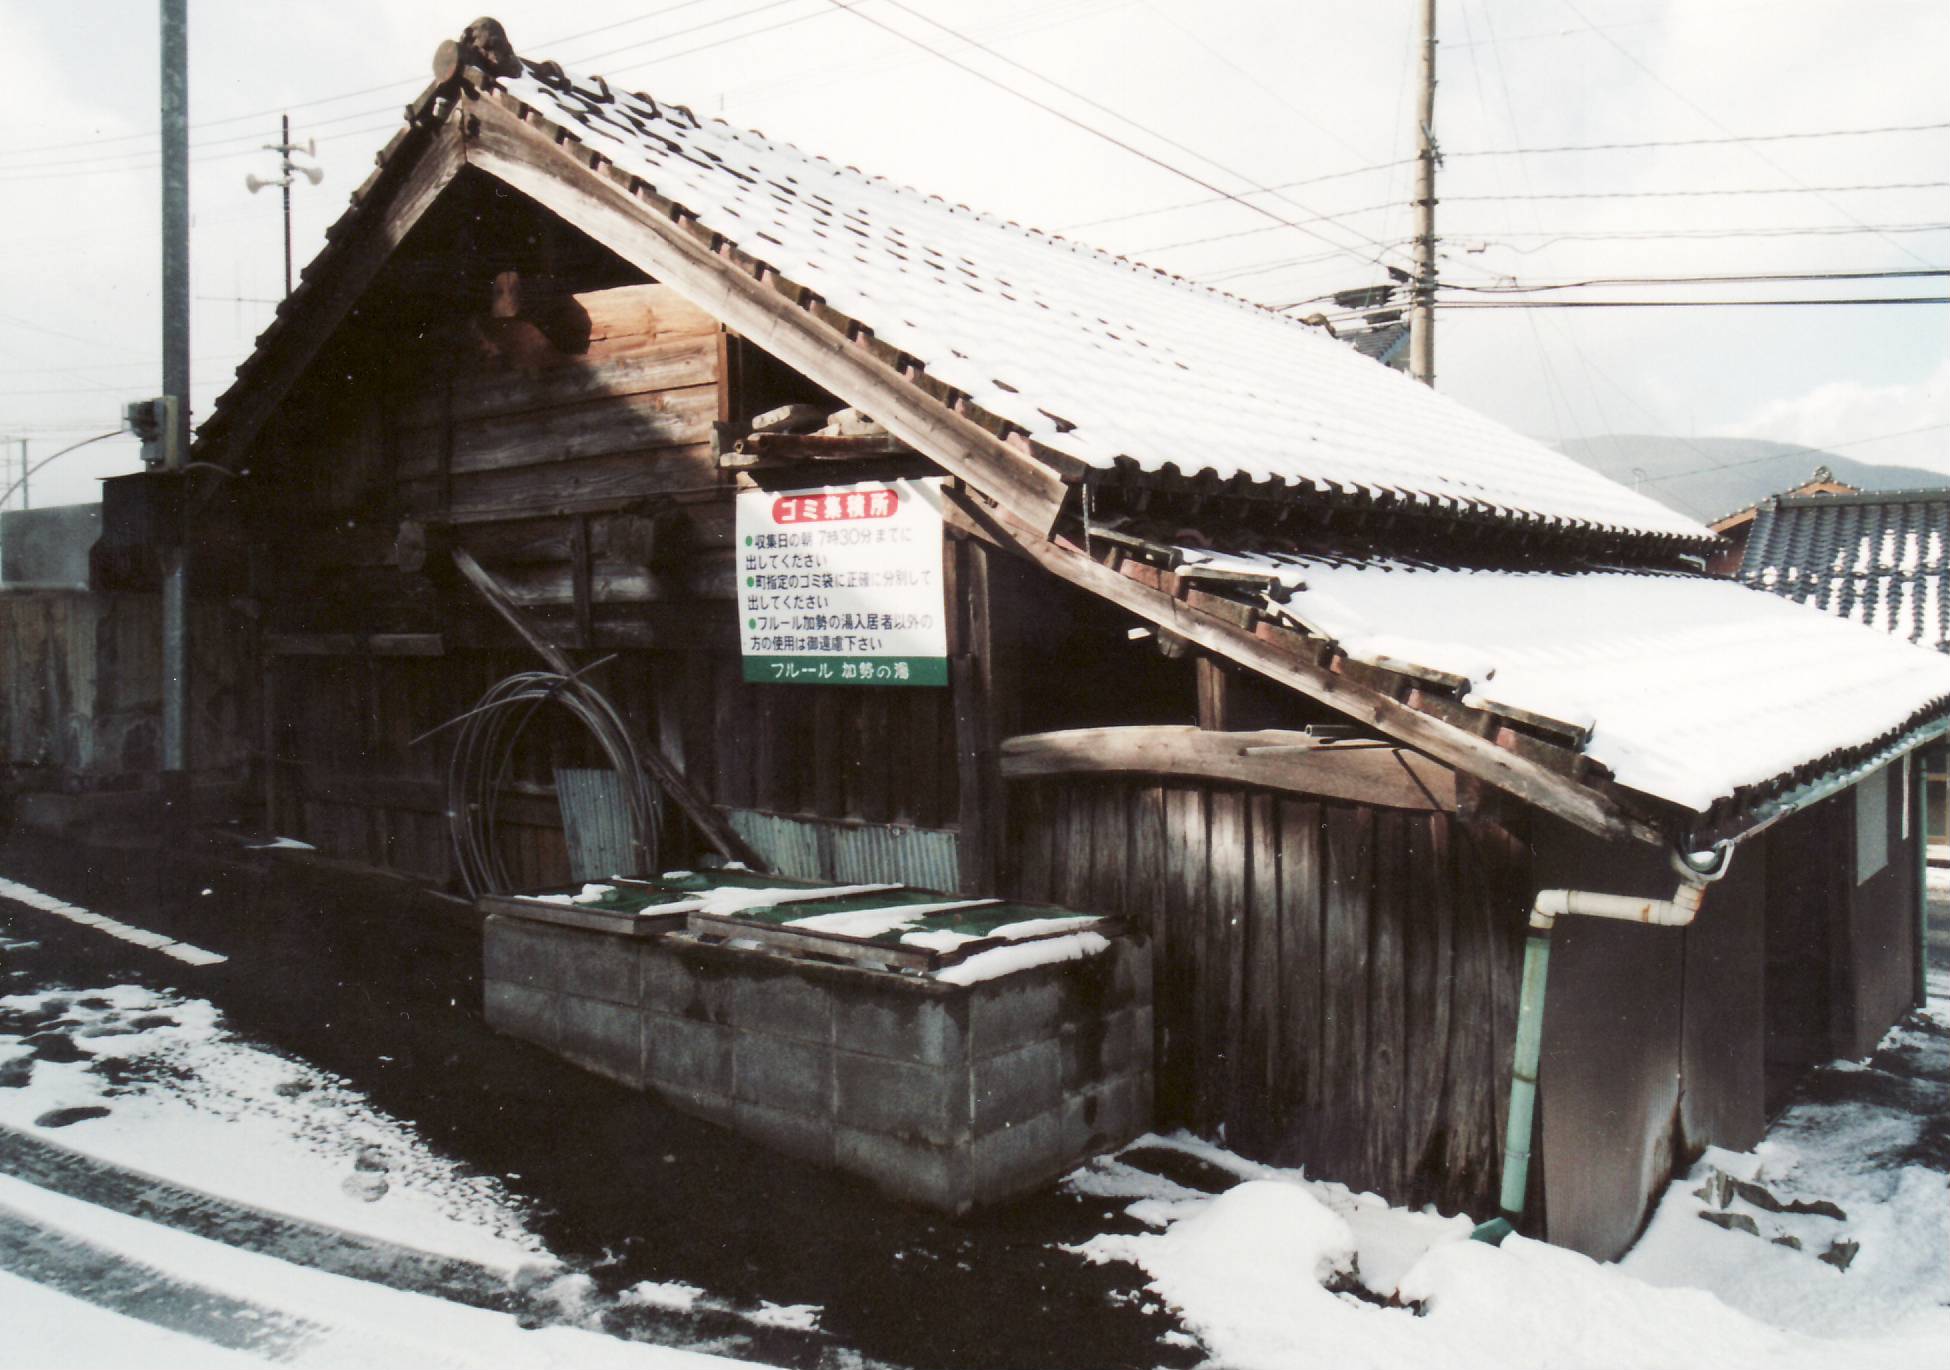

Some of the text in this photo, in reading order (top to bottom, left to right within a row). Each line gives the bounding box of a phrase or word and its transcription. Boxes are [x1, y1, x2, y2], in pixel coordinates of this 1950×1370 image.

[746, 554, 827, 571] 出してください
[748, 595, 828, 611] 出してください
[751, 635, 882, 652] 方の使用は御遠慮下さい
